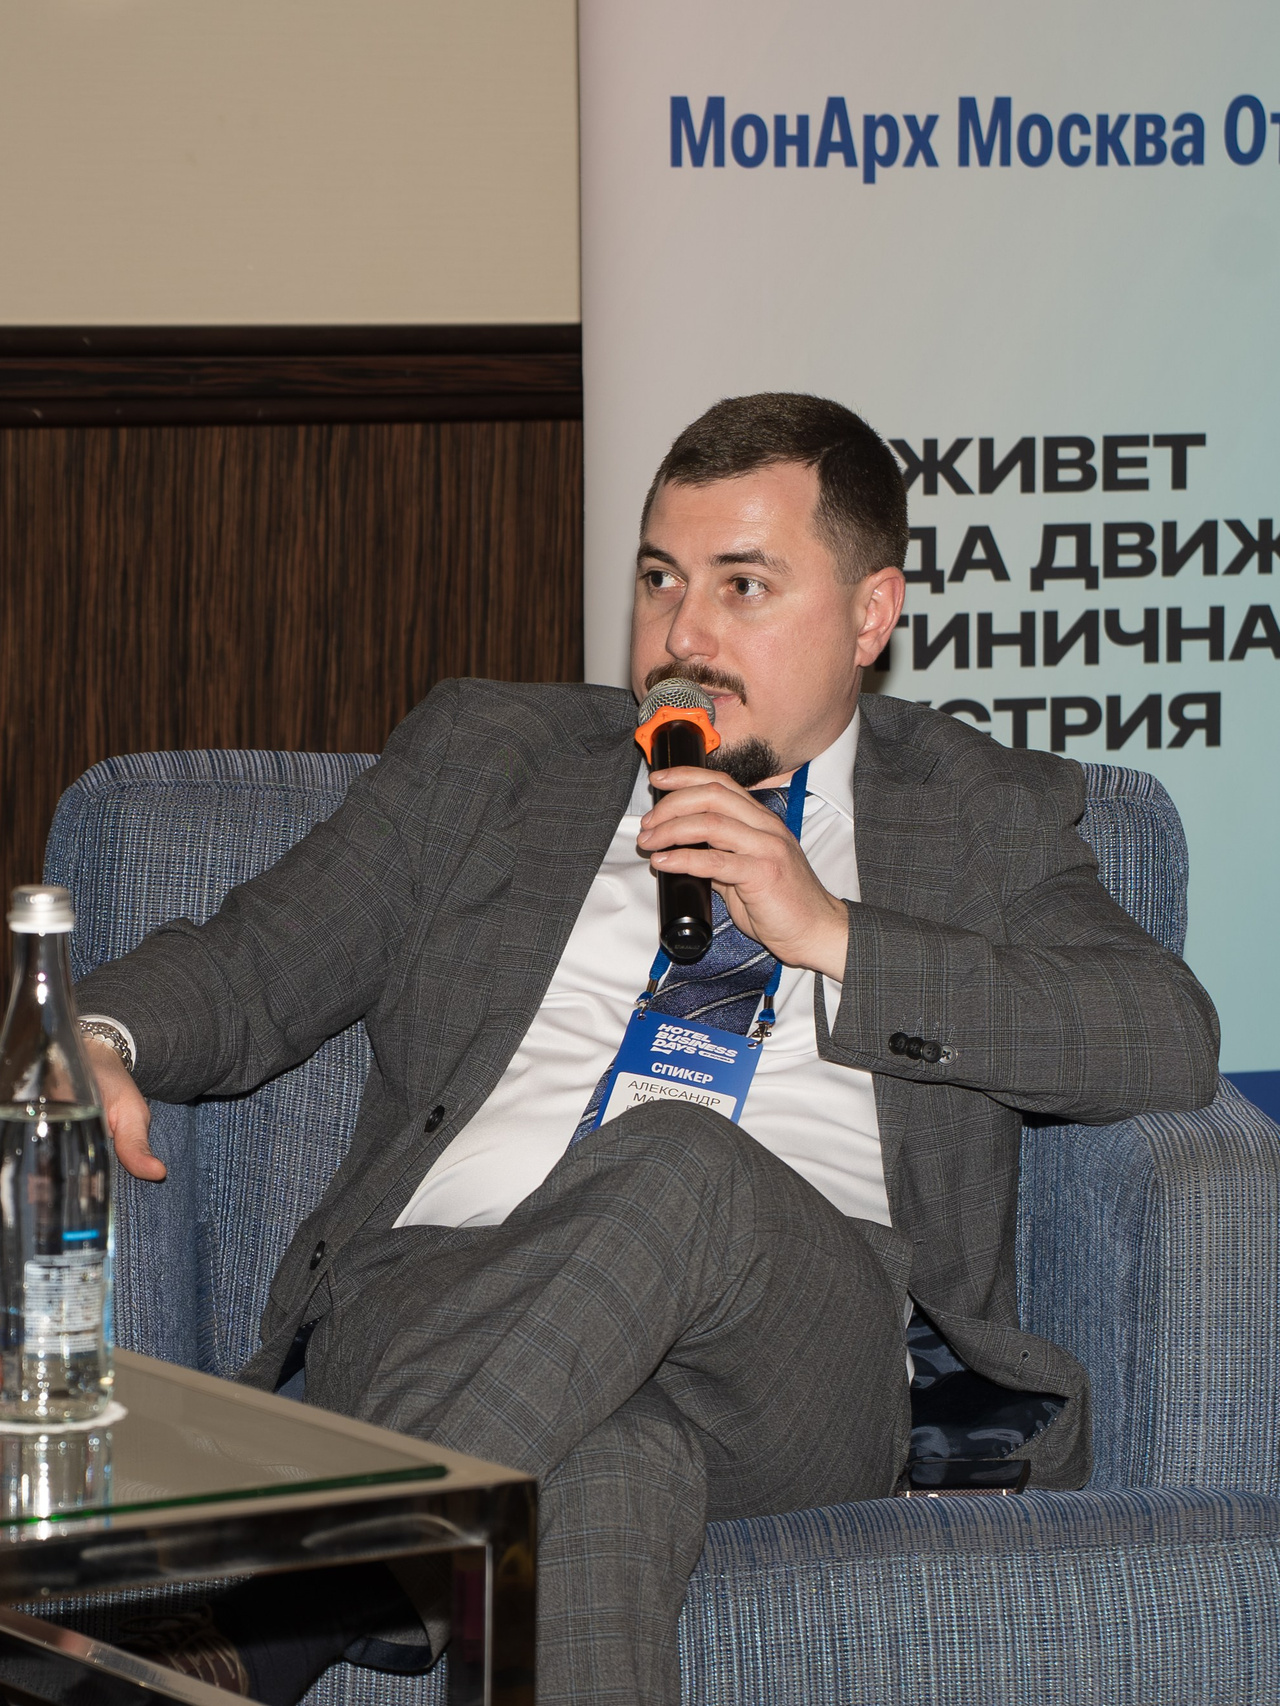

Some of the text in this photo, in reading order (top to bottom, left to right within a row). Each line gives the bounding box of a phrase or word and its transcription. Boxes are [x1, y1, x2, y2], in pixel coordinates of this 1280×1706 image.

[670, 96, 940, 184] МонАрх
[958, 96, 1205, 167] Москва
[888, 434, 1206, 495] ЖИВЕТ
[1030, 518, 1280, 591] ДВИЖ
[655, 1031, 738, 1057] BUSINESS
[657, 1023, 711, 1043] HOTEL
[652, 1039, 697, 1054] DAYS
[651, 1062, 714, 1084] СПИКЕР
[628, 1080, 721, 1107] АЛЕКСАНДР
